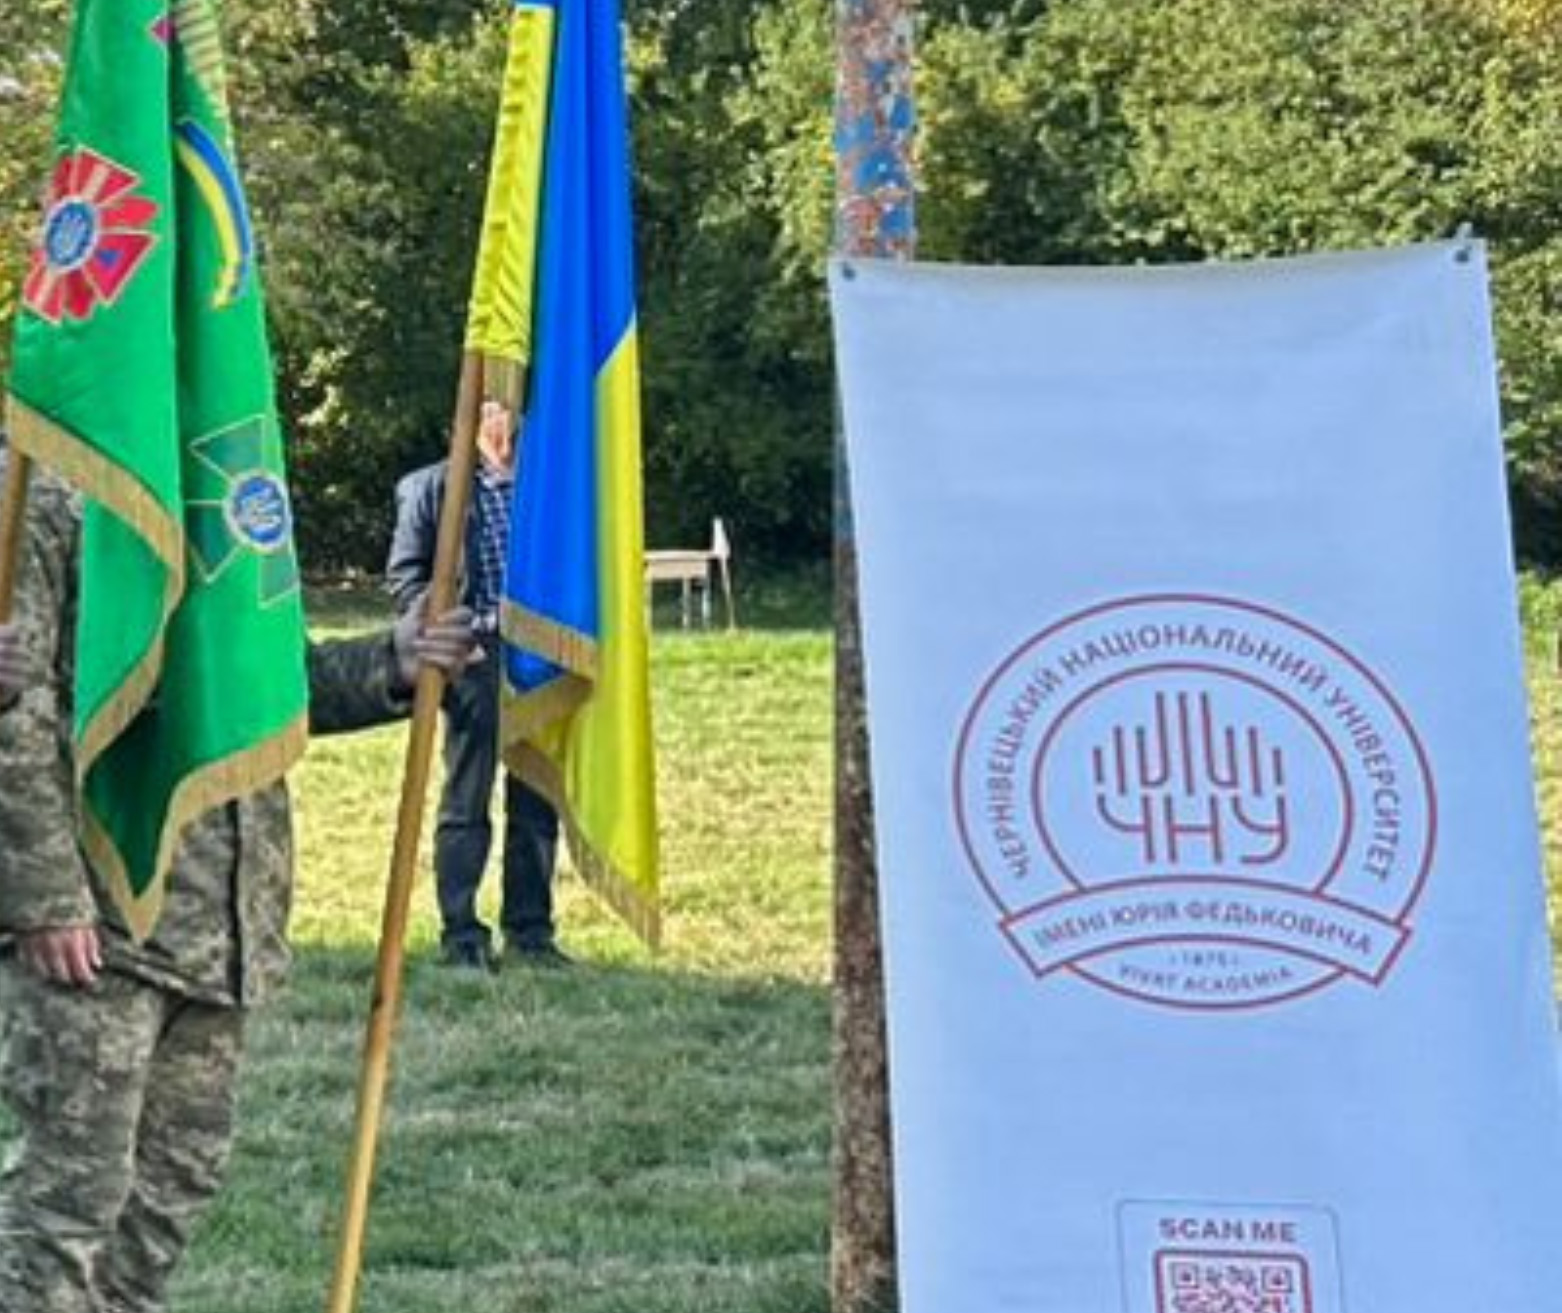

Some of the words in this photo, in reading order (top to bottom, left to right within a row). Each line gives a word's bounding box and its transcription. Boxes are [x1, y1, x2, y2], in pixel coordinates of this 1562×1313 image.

[987, 666, 1064, 879] ЧЕРНІВЕЦЬКИЙ
[1058, 624, 1328, 694] НАЦІОНАЛЬНИЙ
[1323, 687, 1401, 883] УНІВЕРСИТЕТ
[1096, 794, 1289, 865] ЧНУ
[1034, 915, 1106, 948] ІМЕНІ
[1113, 901, 1177, 926] ЮРІЯ
[1183, 900, 1373, 954] ФЕДЬКОВИЧА
[1159, 1218, 1244, 1240] SCAN
[1252, 1221, 1297, 1243] ME
